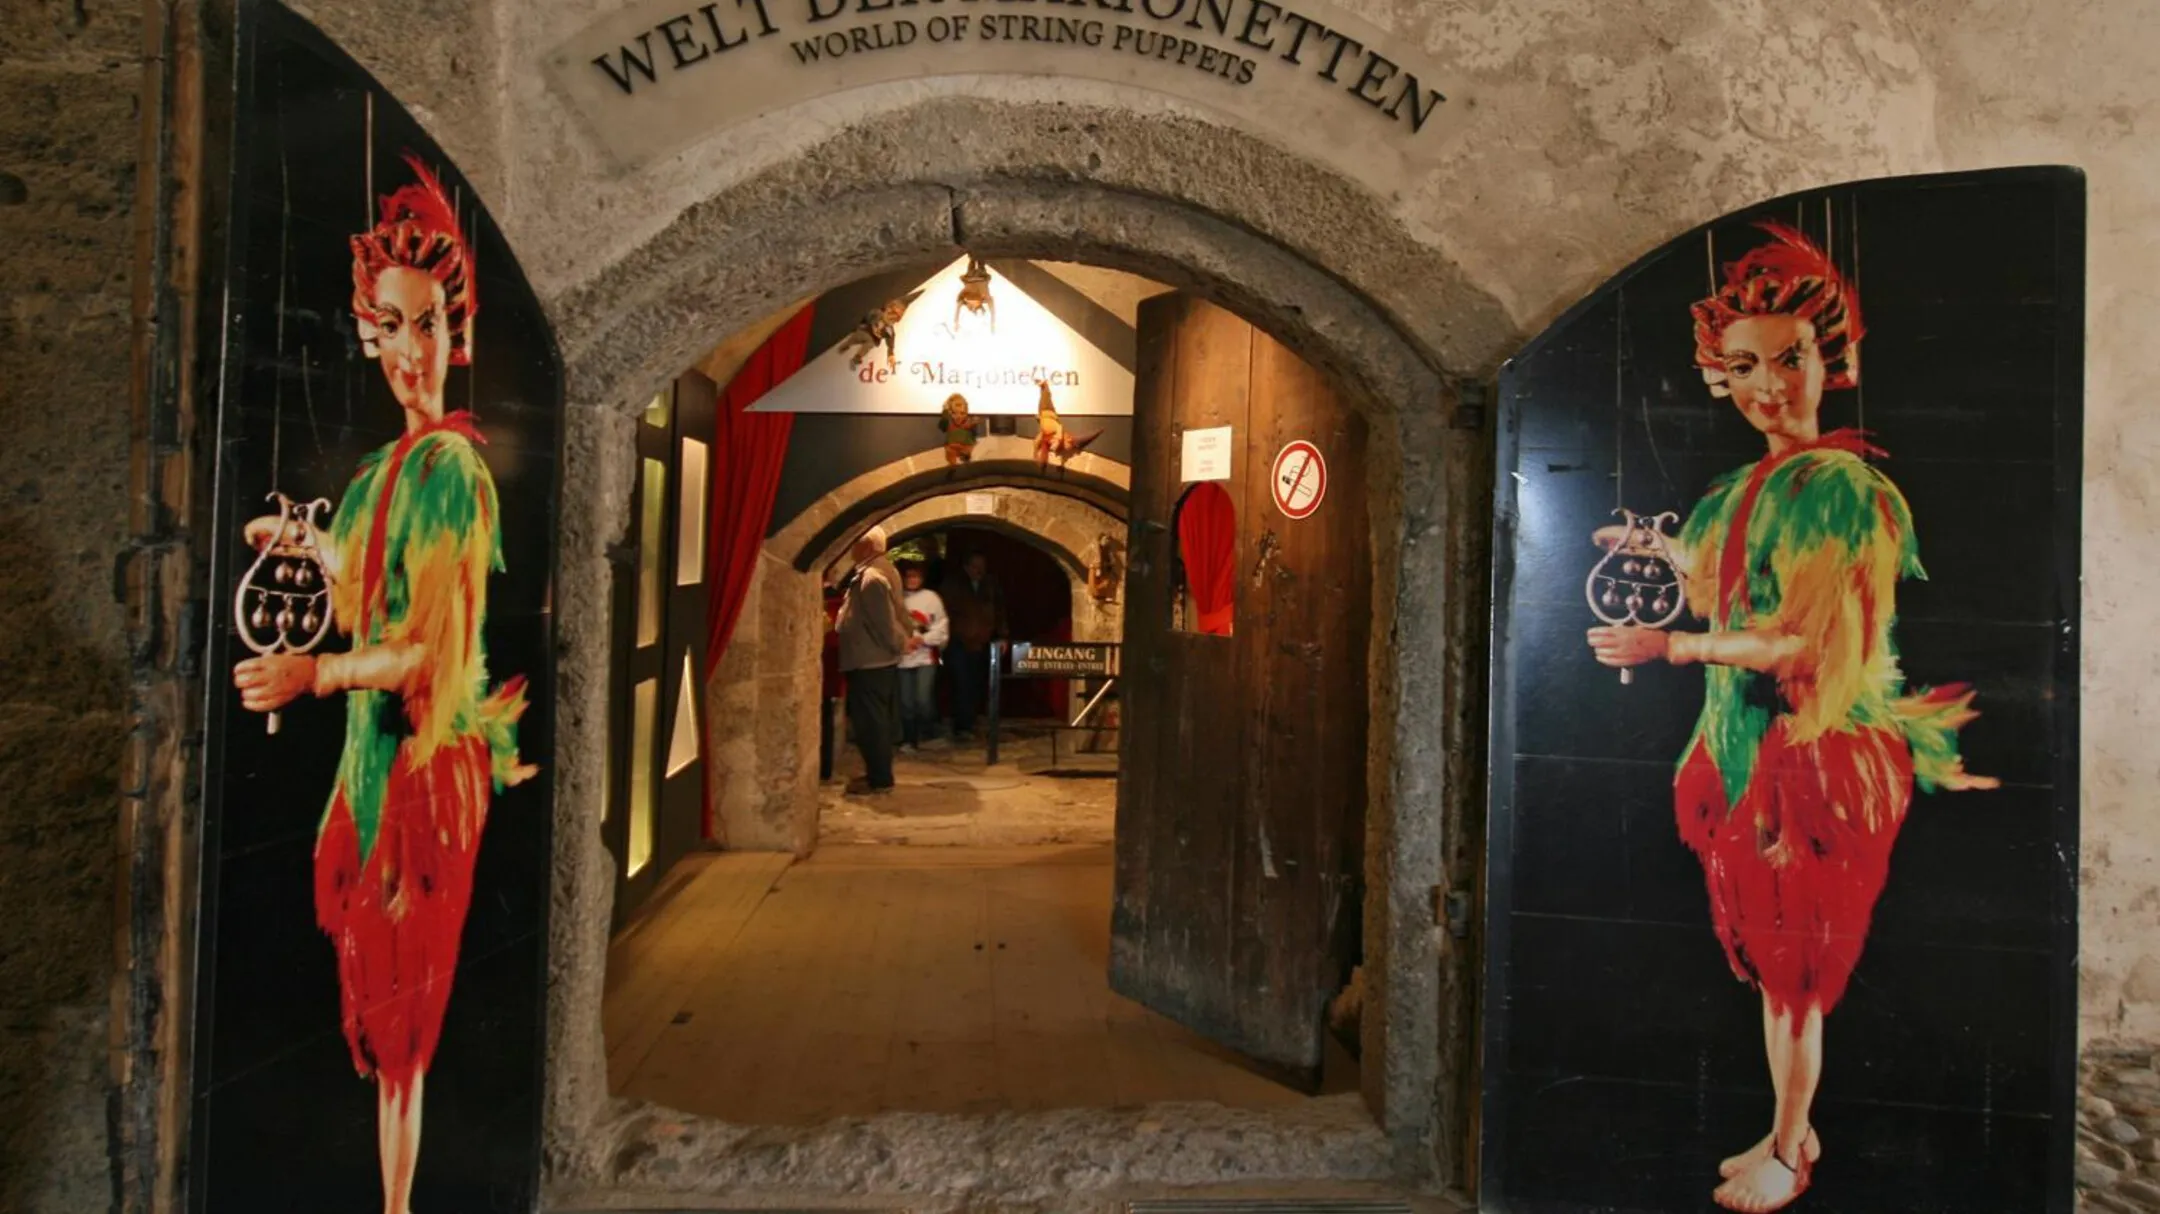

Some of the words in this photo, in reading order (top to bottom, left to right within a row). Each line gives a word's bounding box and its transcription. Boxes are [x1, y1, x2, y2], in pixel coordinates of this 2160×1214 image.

[591, 0, 780, 96] WELT
[790, 20, 917, 65] WORLD
[927, 15, 970, 43] OF
[980, 14, 1104, 46] STRING
[1112, 25, 1257, 85] PUPPETS
[858, 360, 902, 384] der
[1027, 646, 1096, 661] EINGANG
